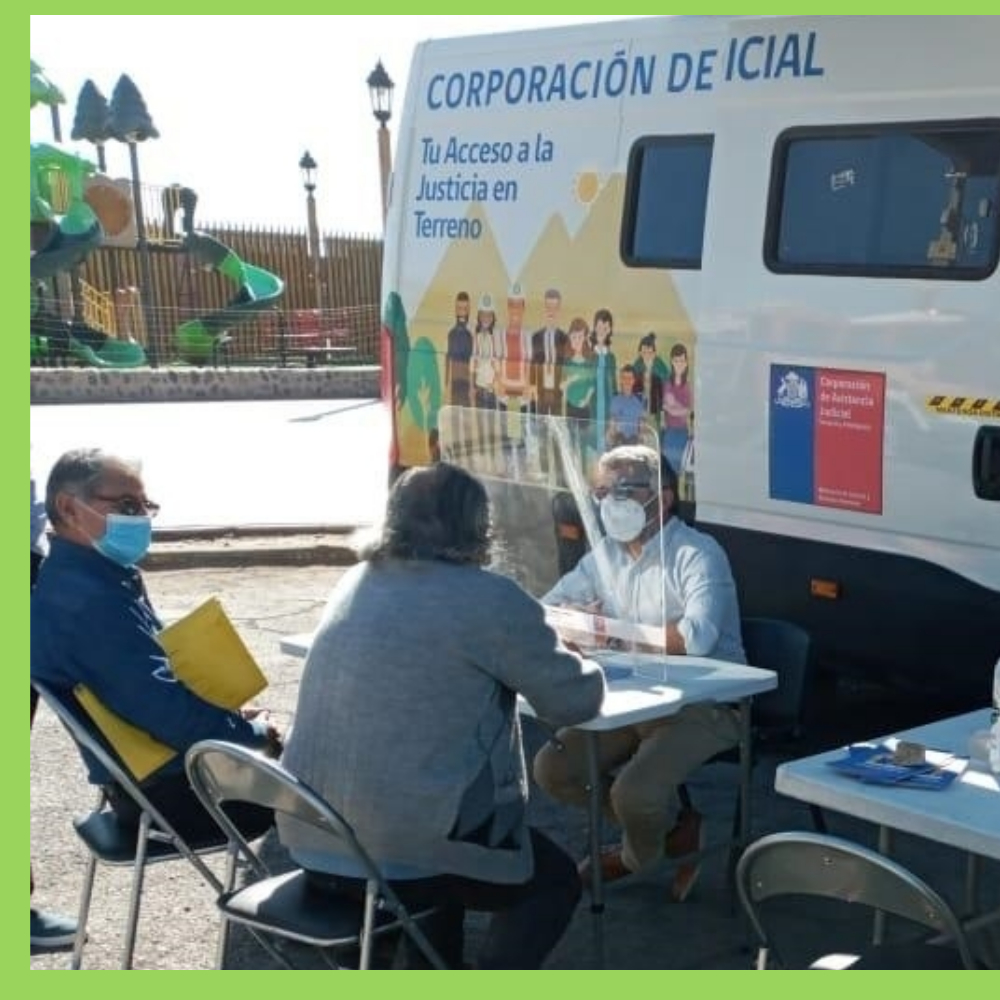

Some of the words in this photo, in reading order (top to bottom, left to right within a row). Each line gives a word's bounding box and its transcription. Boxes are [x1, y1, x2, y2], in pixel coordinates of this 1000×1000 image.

[427, 49, 657, 110] CORPORACIÓN
[666, 49, 718, 93] DE
[725, 32, 824, 82] ICIAL
[422, 137, 441, 165] Tu
[443, 136, 513, 164] Acceso
[517, 141, 530, 163] a
[535, 133, 553, 163] la
[415, 172, 488, 202] Justicia
[493, 180, 518, 202] en
[414, 210, 482, 239] Terreno
